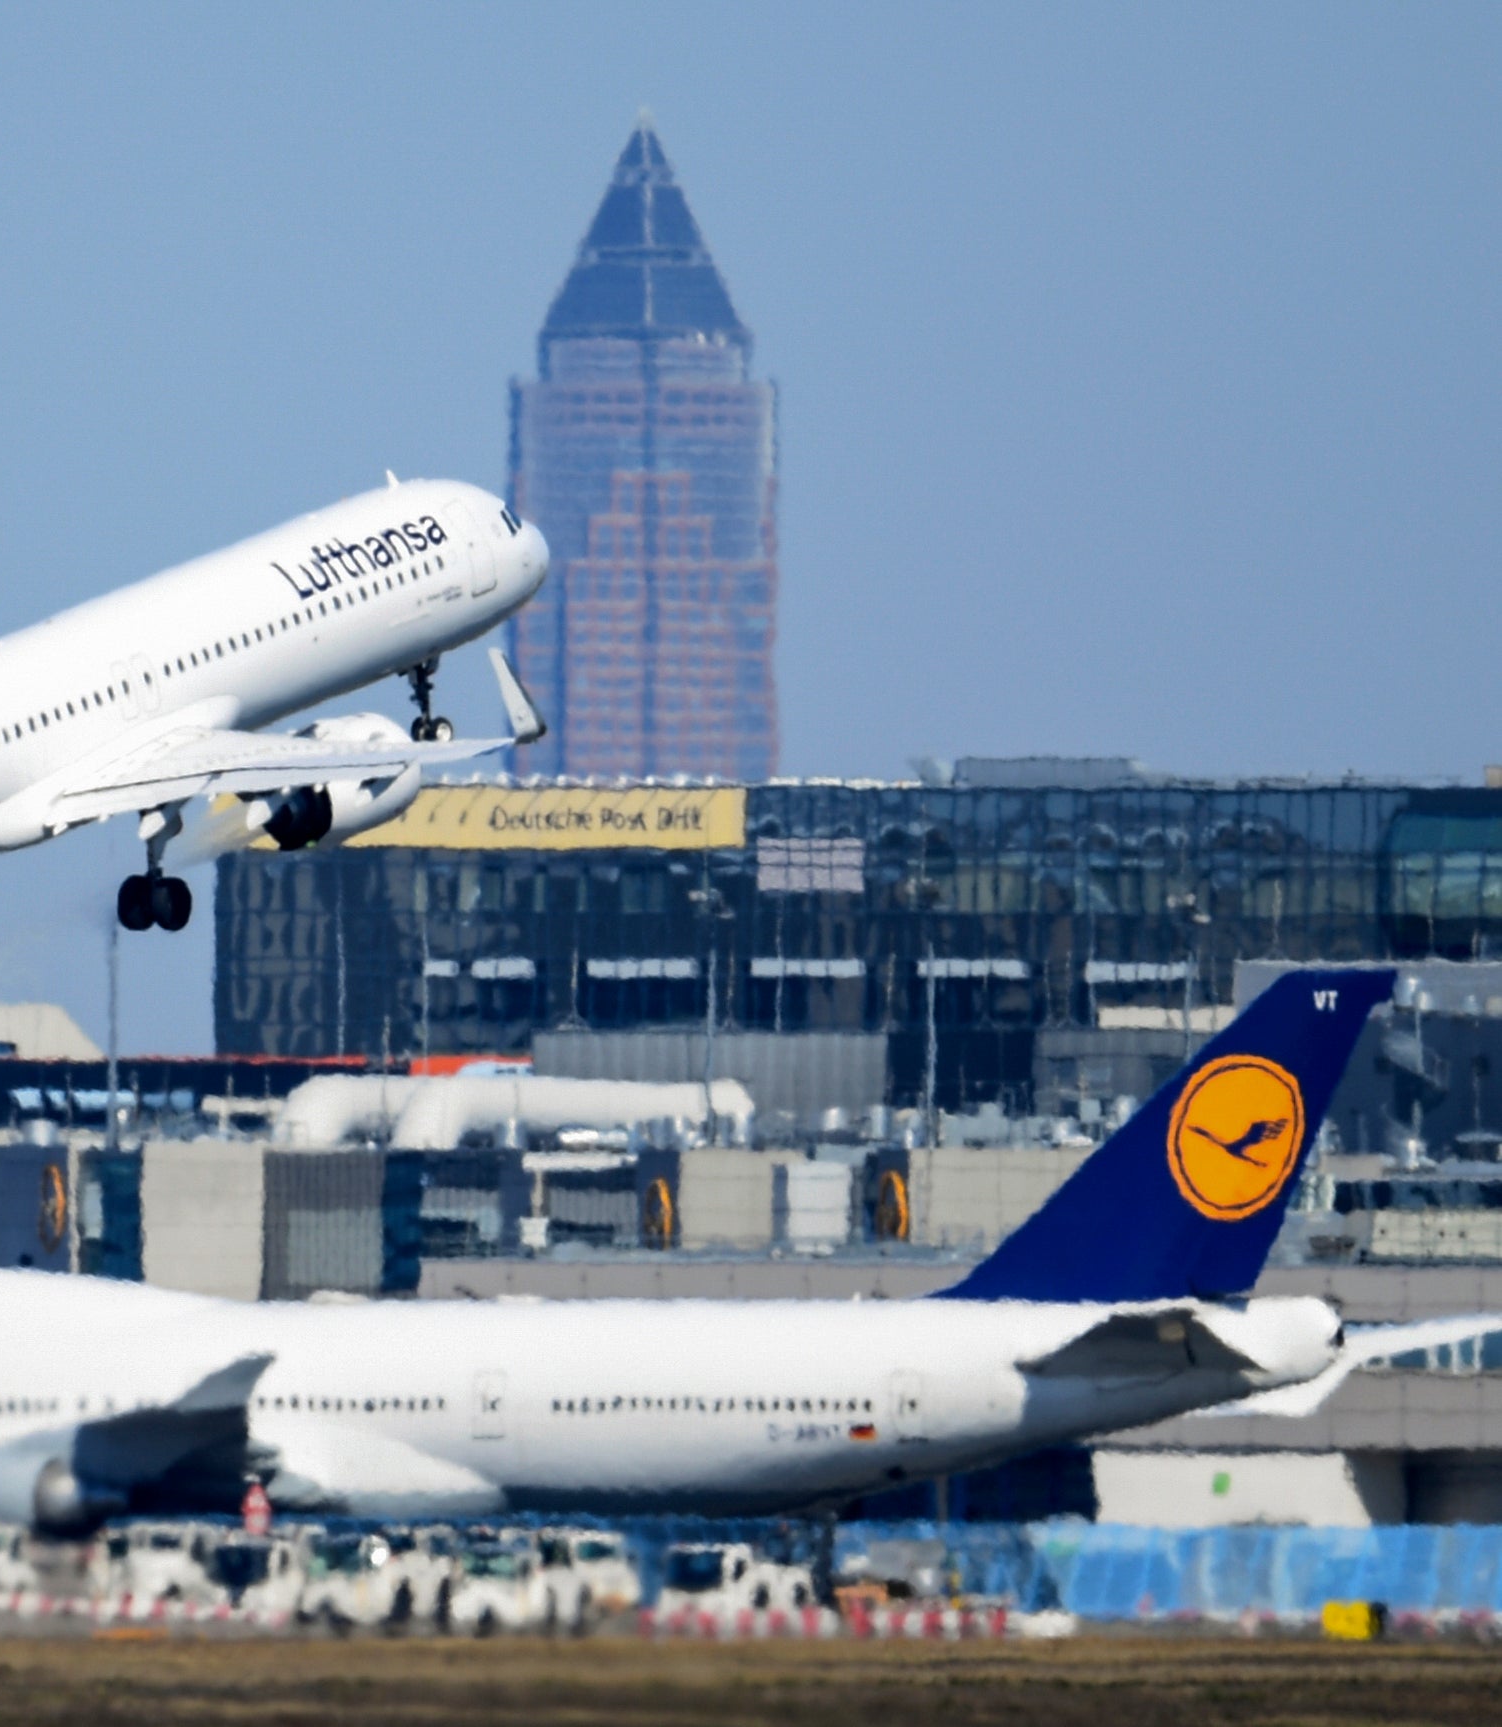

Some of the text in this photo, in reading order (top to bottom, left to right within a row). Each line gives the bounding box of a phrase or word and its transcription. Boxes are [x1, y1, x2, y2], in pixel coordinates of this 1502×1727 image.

[270, 515, 448, 600] Lufthansa
[489, 805, 592, 831] Deutsche
[657, 805, 703, 831] DHL
[1313, 990, 1338, 1011] VT
